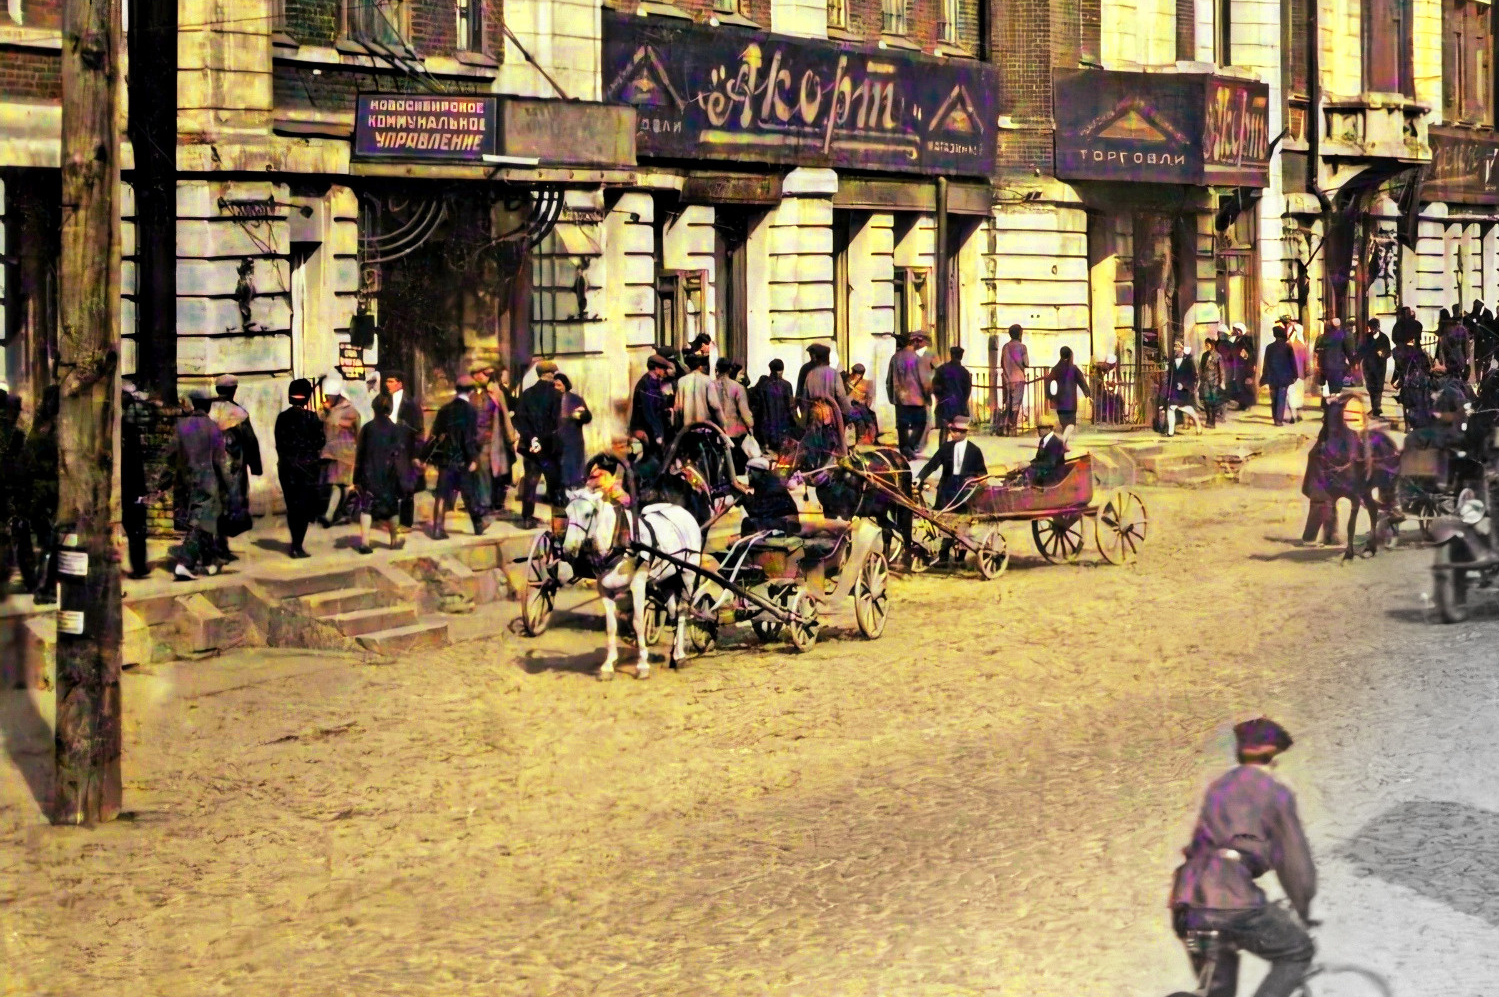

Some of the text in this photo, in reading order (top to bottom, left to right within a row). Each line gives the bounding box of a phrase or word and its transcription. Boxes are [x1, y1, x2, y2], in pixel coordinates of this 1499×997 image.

[368, 114, 486, 131] КОММУНАЛЬНОЕ
[375, 131, 484, 151] УПРАВЛЕНИЕ
[1079, 149, 1186, 167] ТОРГОВЛИ
